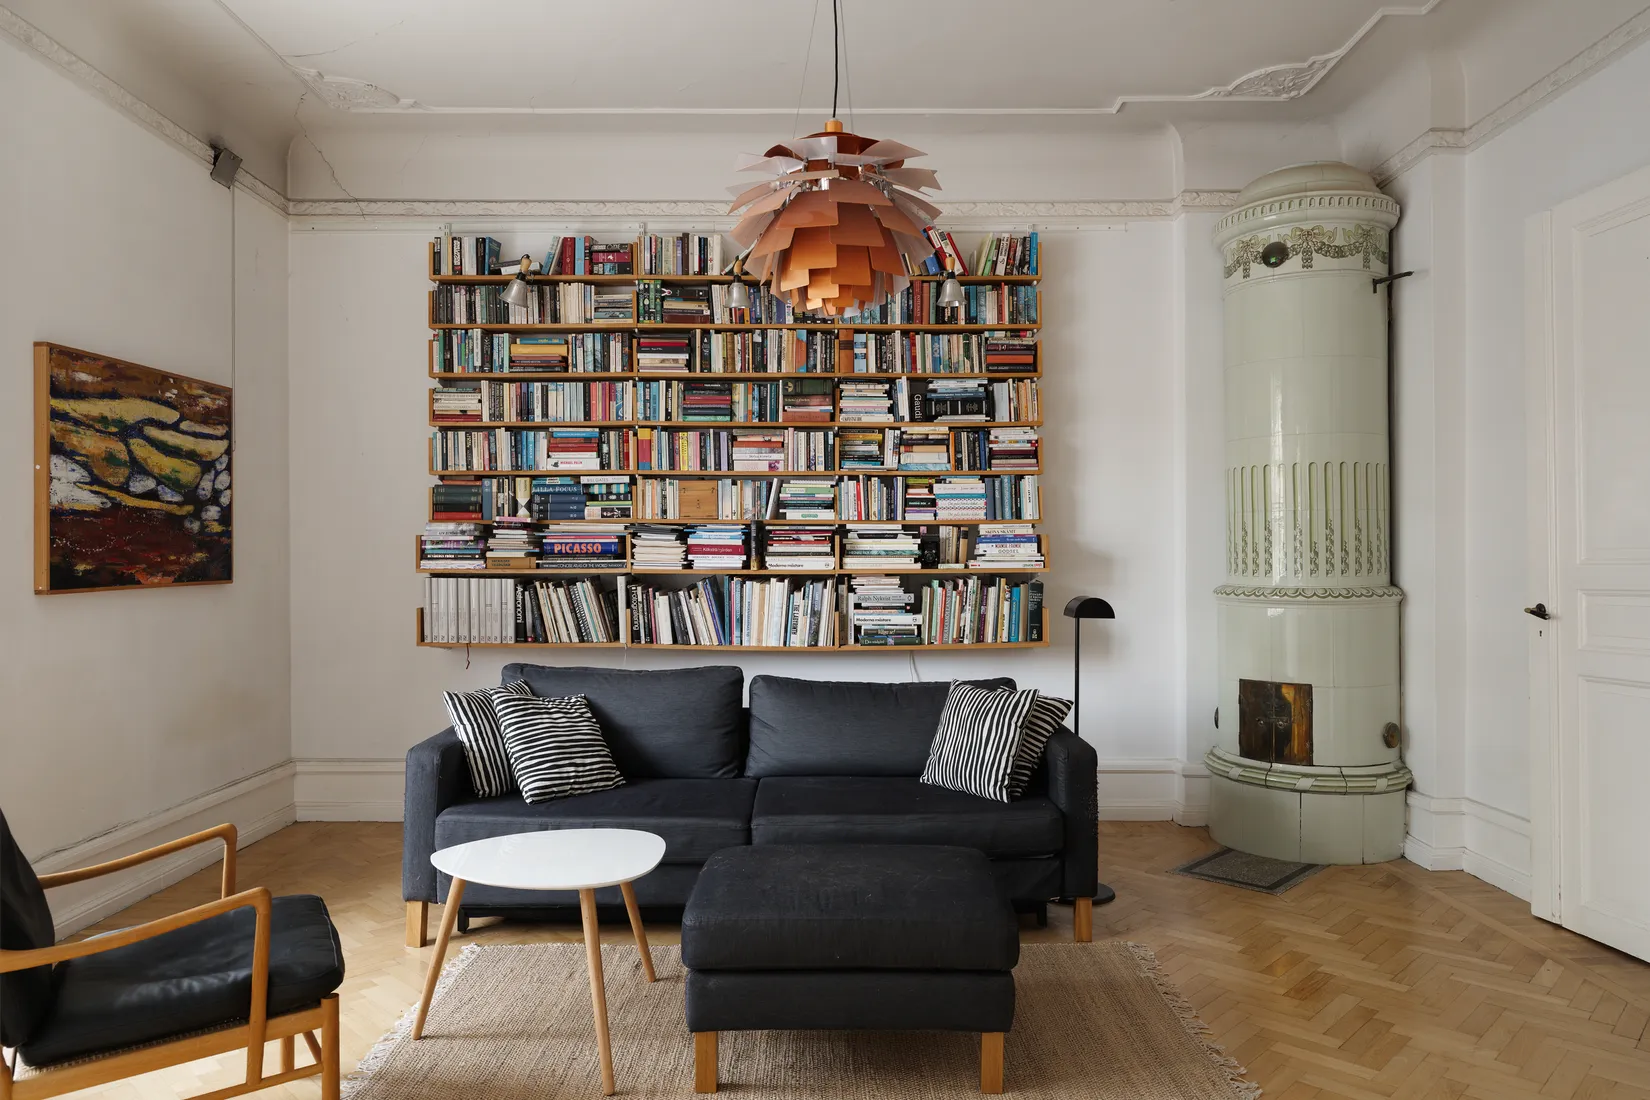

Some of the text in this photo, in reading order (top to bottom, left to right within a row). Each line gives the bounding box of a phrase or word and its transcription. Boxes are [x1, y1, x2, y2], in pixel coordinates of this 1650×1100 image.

[914, 394, 923, 419] Gaudí
[553, 543, 602, 554] PICASSO
[516, 586, 524, 623] Astronomi
